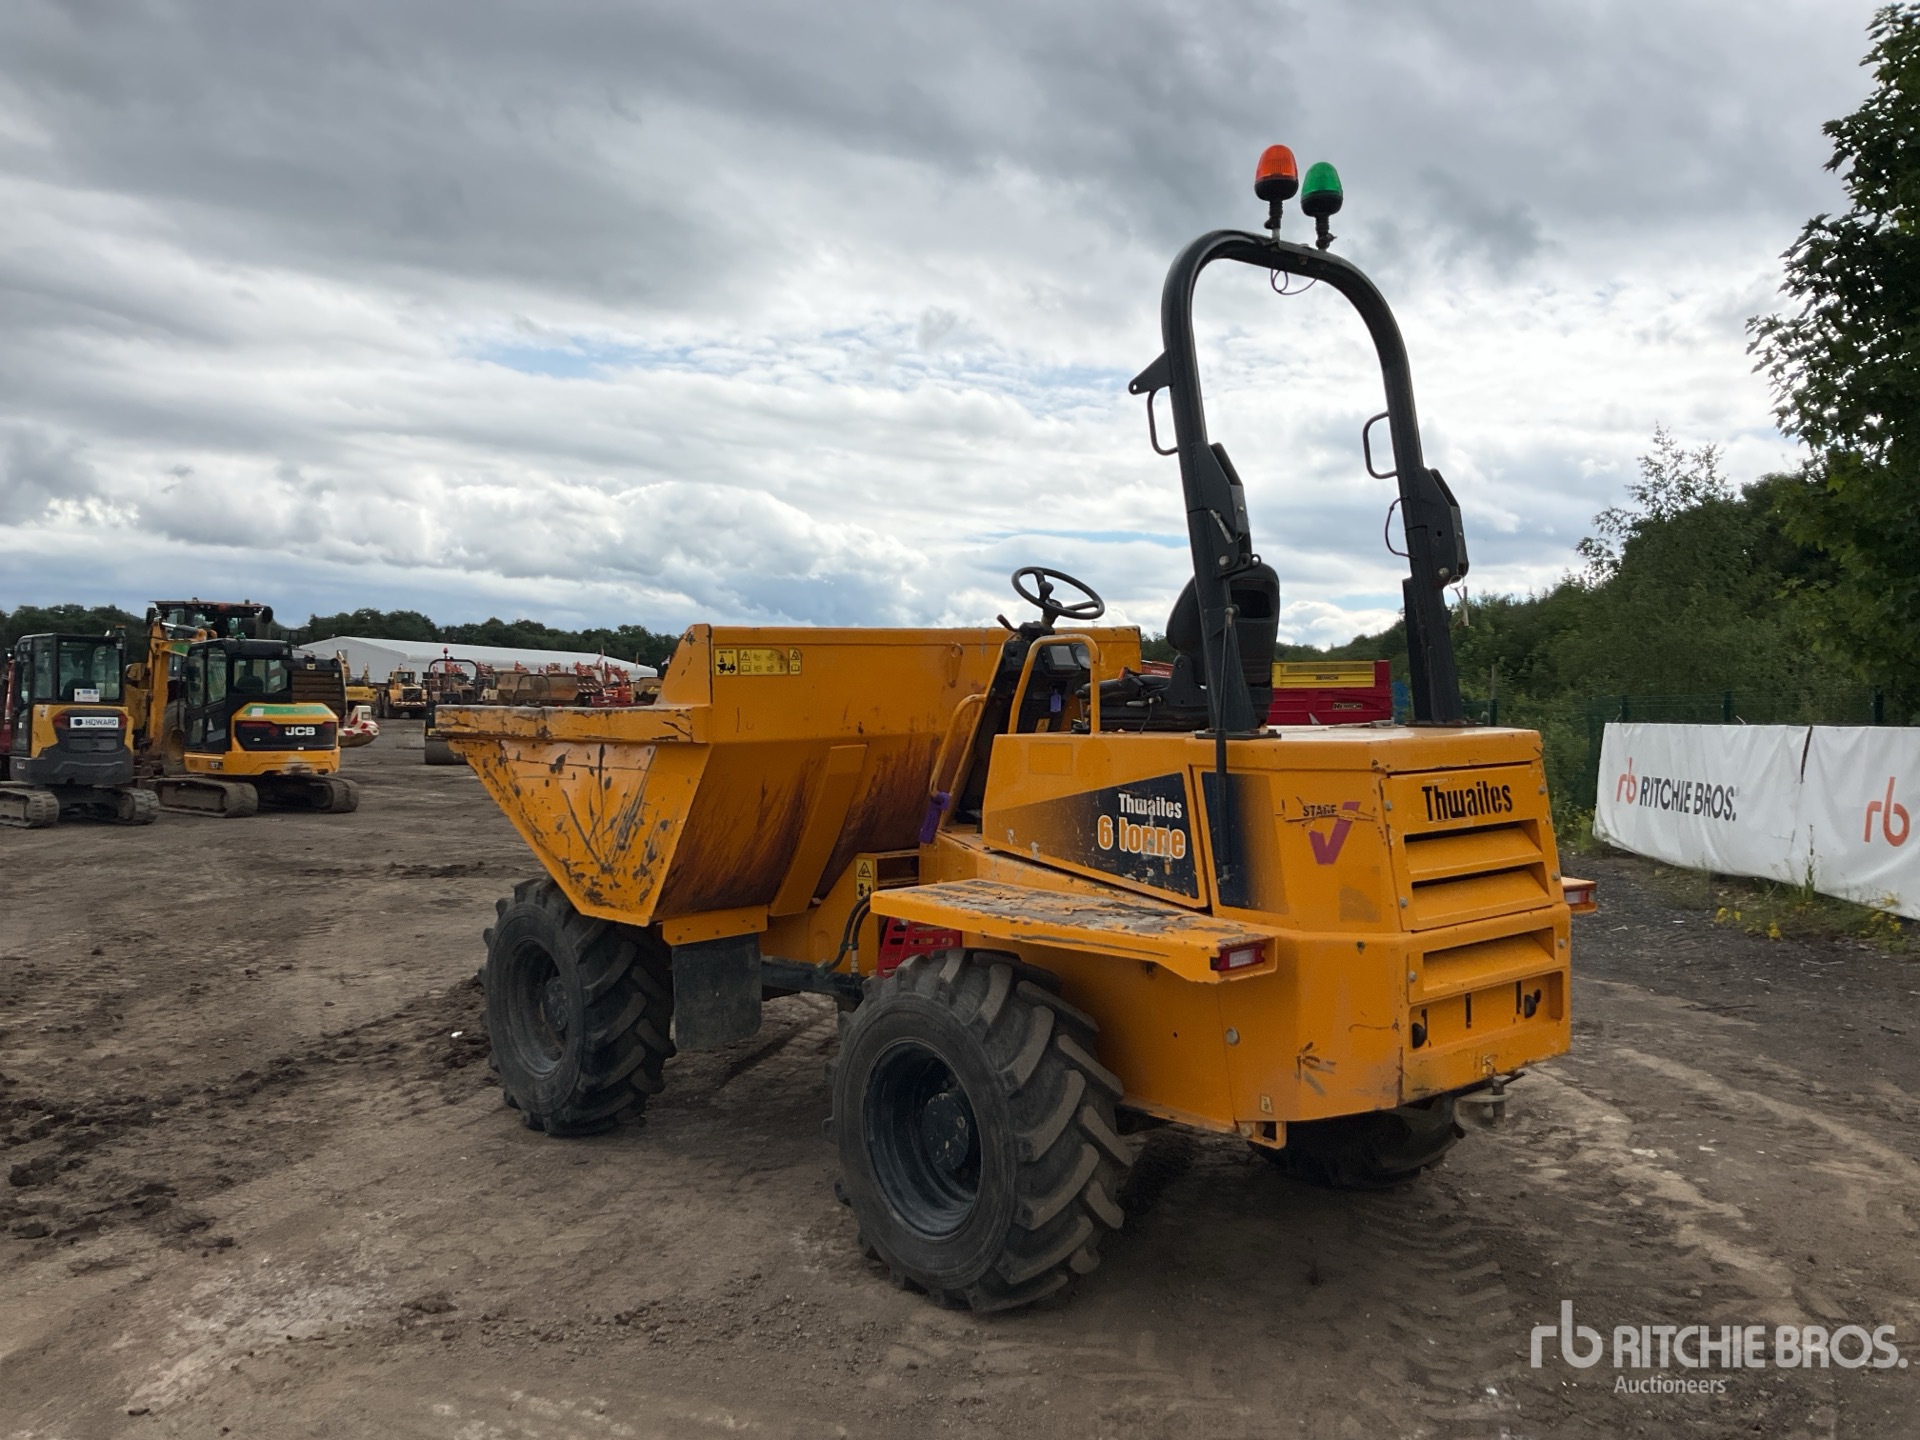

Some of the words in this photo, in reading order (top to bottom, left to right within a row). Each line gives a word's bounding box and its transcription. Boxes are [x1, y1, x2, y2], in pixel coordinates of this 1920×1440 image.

[285, 726, 316, 736] JCB
[1118, 793, 1182, 819] Thwaites
[1422, 780, 1513, 822] Thwaites
[1616, 757, 1637, 805] rb
[1639, 776, 1693, 813] RITCHIE
[1693, 782, 1737, 822] BROS.
[1863, 776, 1911, 847] rb
[1097, 814, 1114, 851] 6
[1118, 816, 1186, 860] tonne
